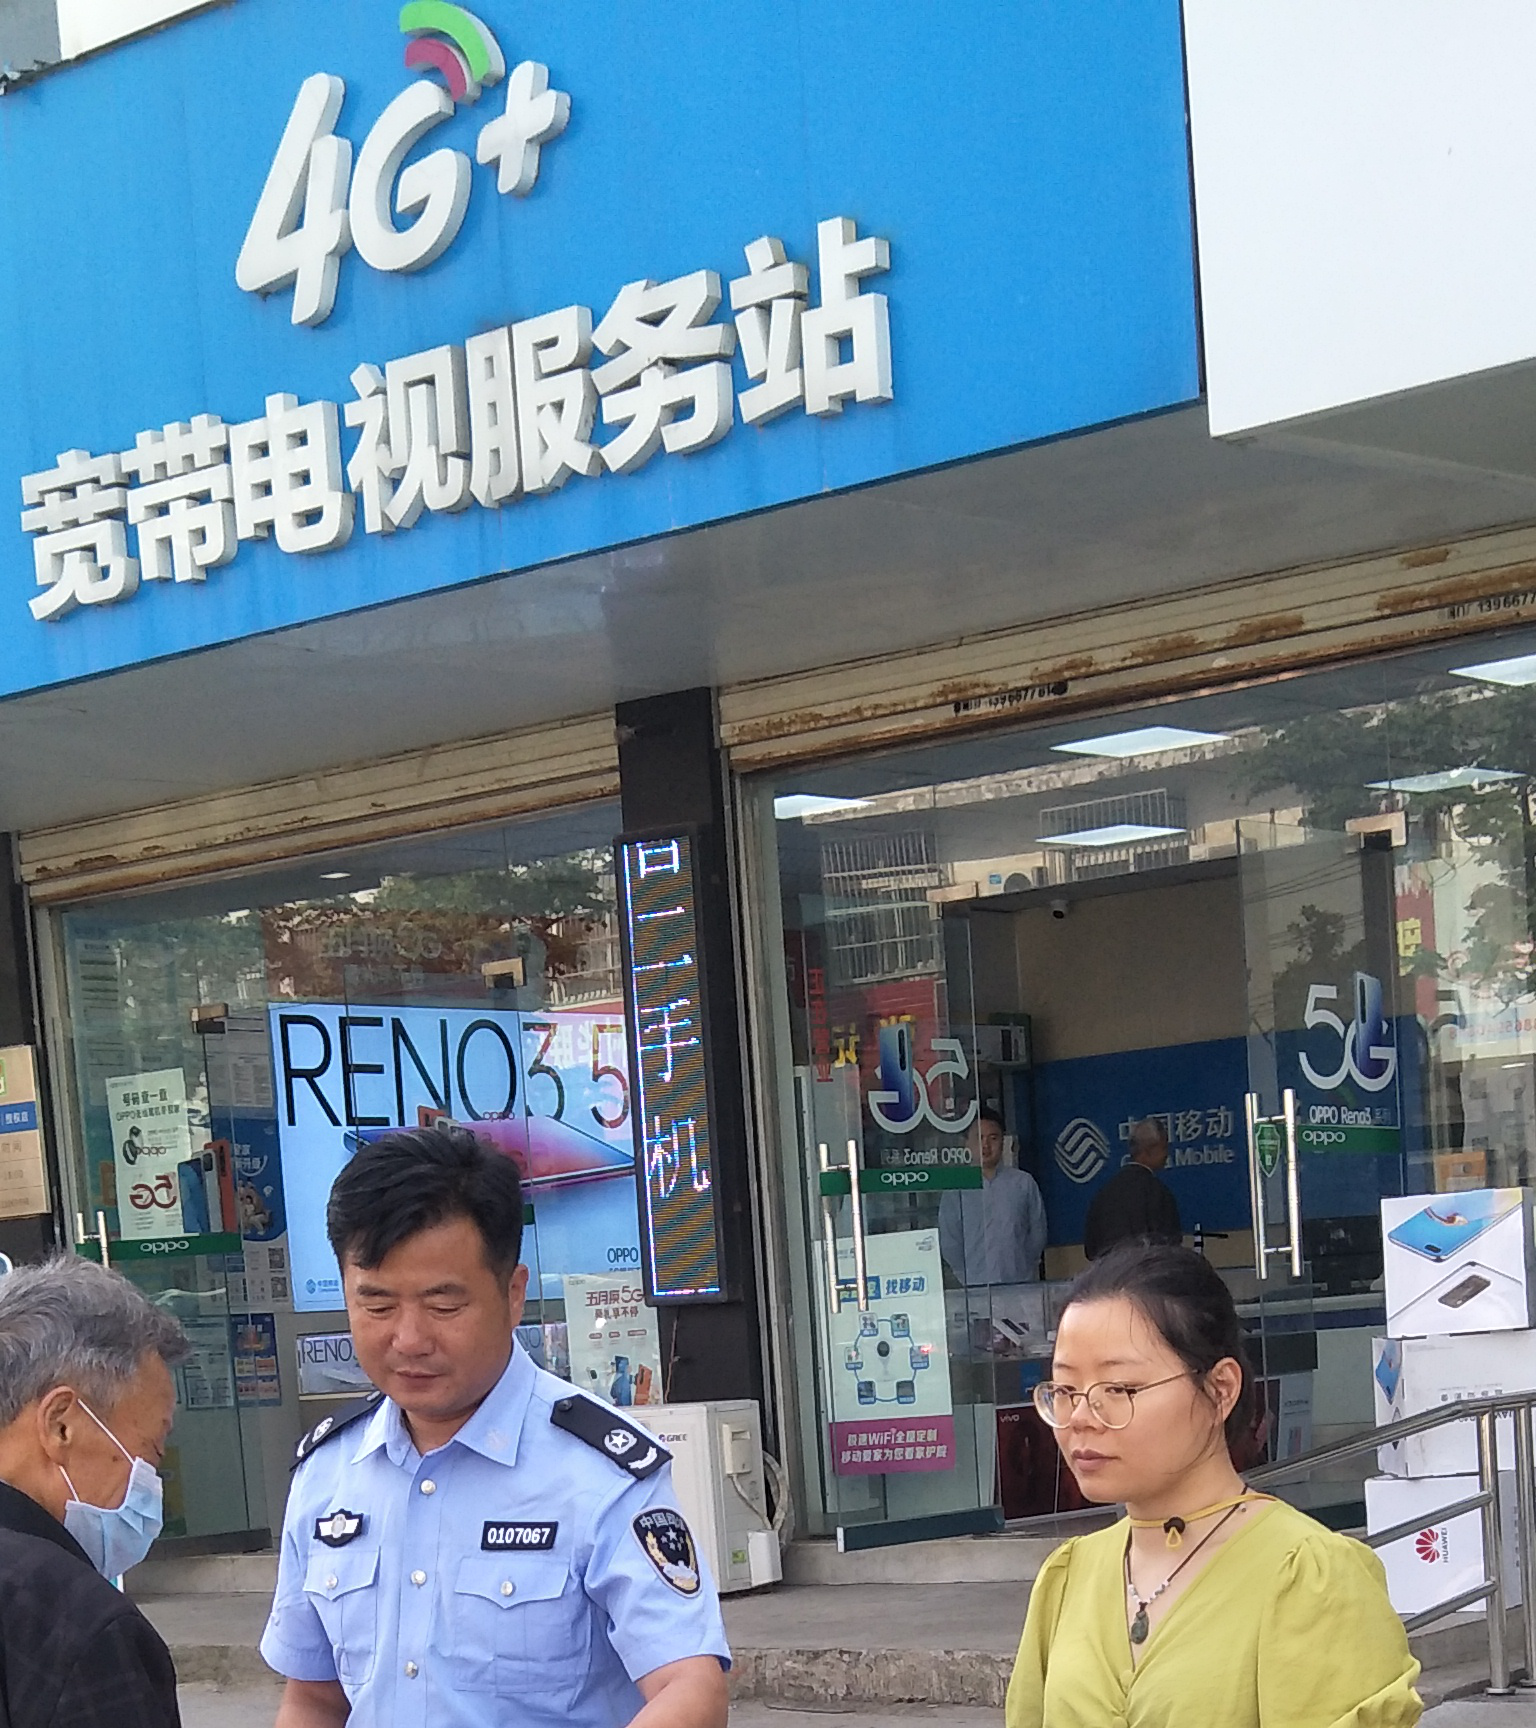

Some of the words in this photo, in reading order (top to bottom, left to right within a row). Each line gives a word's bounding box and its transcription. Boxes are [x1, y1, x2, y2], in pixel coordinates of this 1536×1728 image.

[20, 216, 894, 623] 宽带电视服务站
[1298, 985, 1396, 1092] 5G
[1309, 1106, 1339, 1124] OPPO
[1341, 1107, 1372, 1125] Reno3
[1302, 1130, 1346, 1145] oppo
[1175, 1147, 1234, 1167] Mobile
[881, 1172, 929, 1186] oppo
[140, 1239, 190, 1255] oppo
[607, 1247, 639, 1263] OPPO
[886, 1276, 925, 1295] 找移动
[301, 1337, 358, 1364] RENO
[1000, 1413, 1020, 1423] vivo
[487, 1527, 551, 1544] 0107067
[1441, 1527, 1449, 1563] HUAWEI
